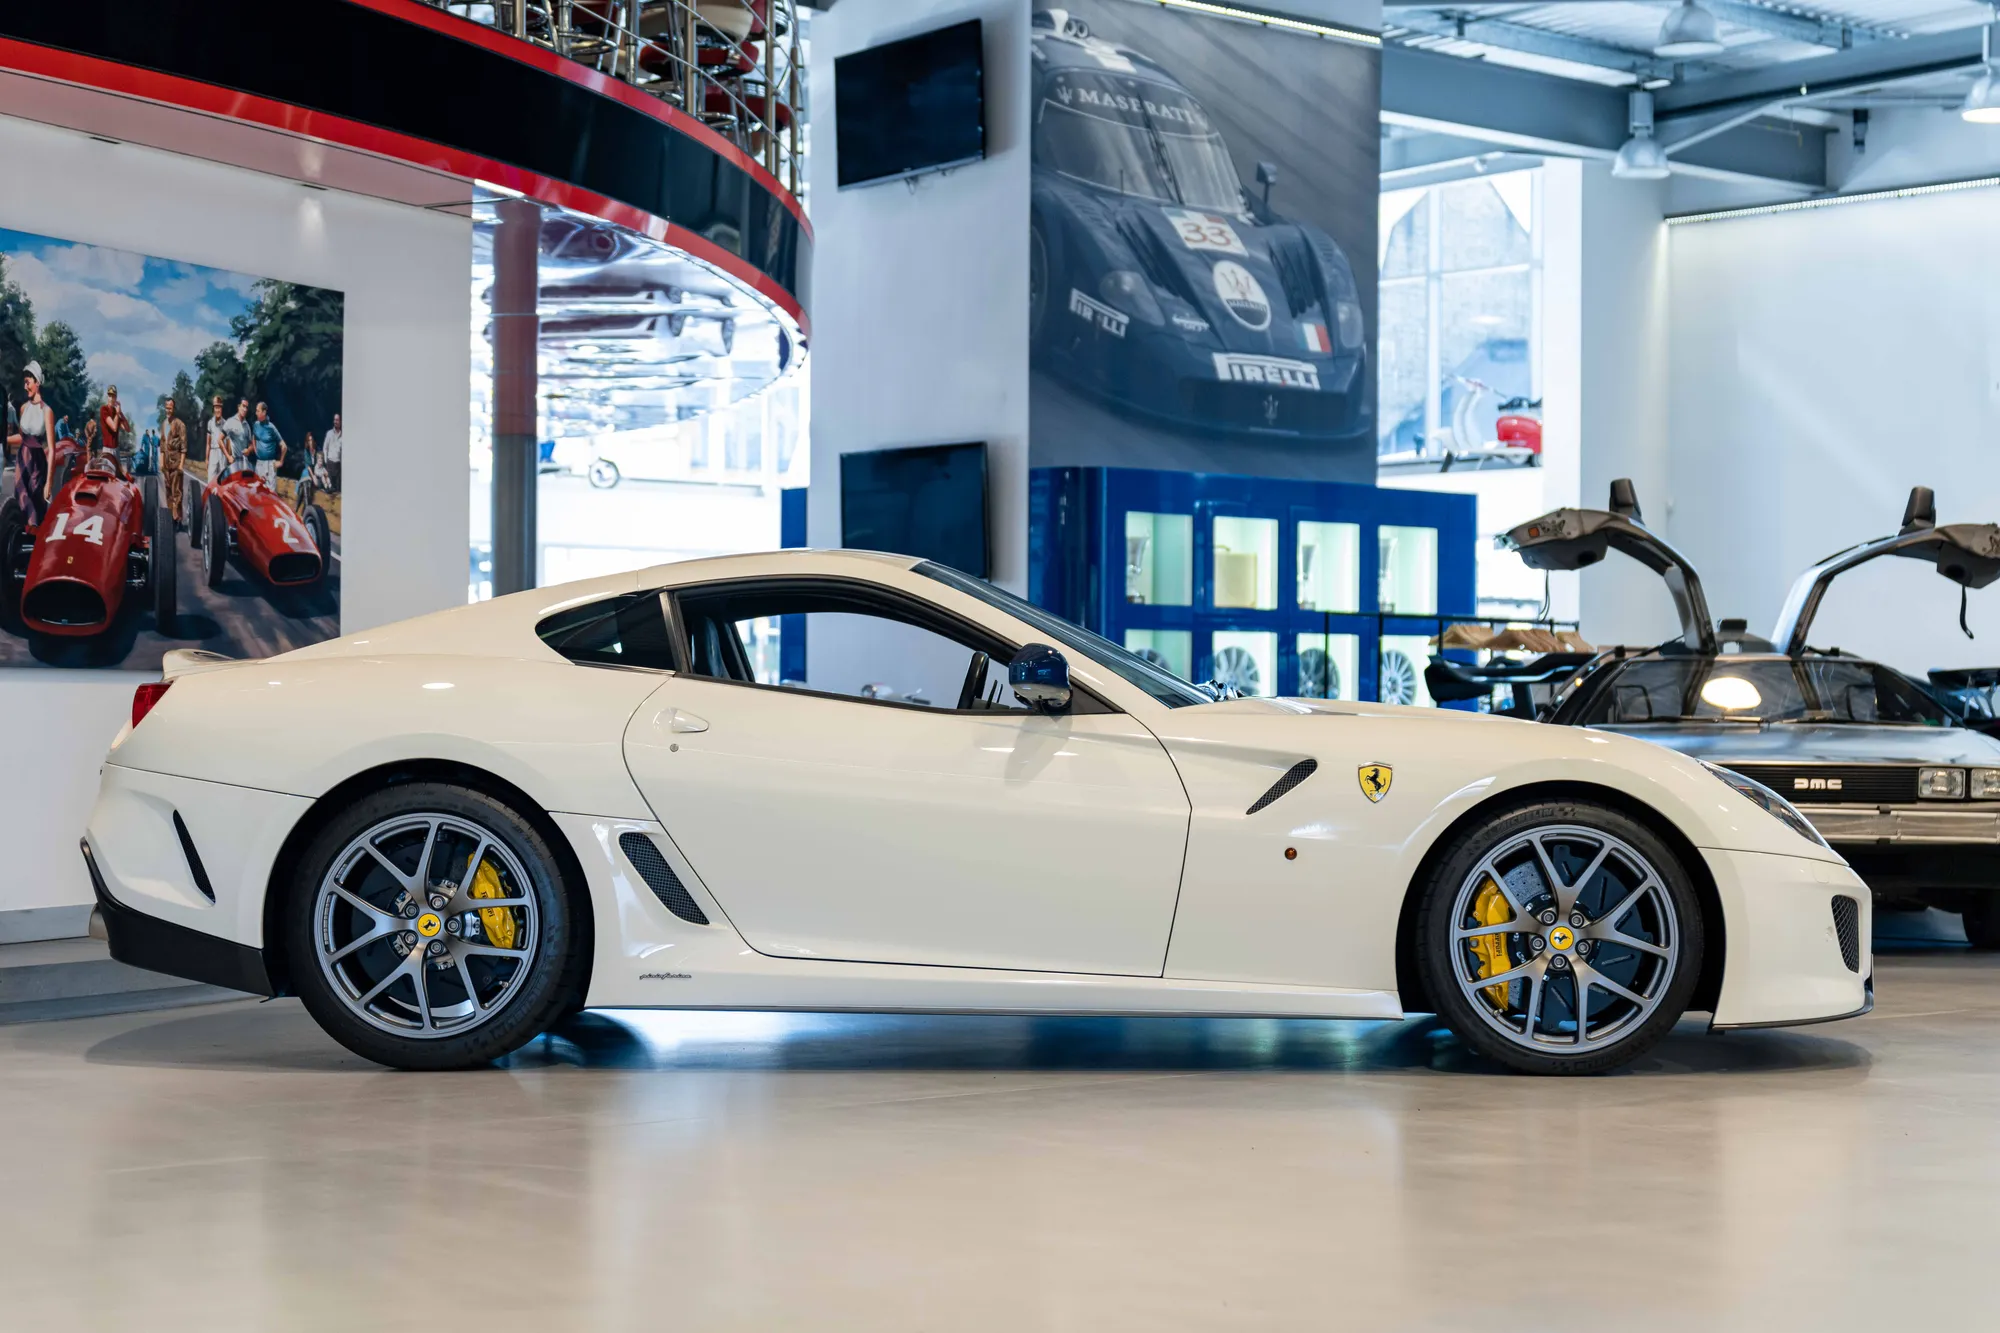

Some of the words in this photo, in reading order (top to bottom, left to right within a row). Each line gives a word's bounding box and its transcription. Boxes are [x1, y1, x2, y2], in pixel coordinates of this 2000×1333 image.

[1078, 87, 1195, 125] MASERATI
[1182, 222, 1232, 246] 33
[1212, 352, 1321, 391] PIRELLI
[45, 512, 104, 546] 14
[274, 517, 299, 544] 2
